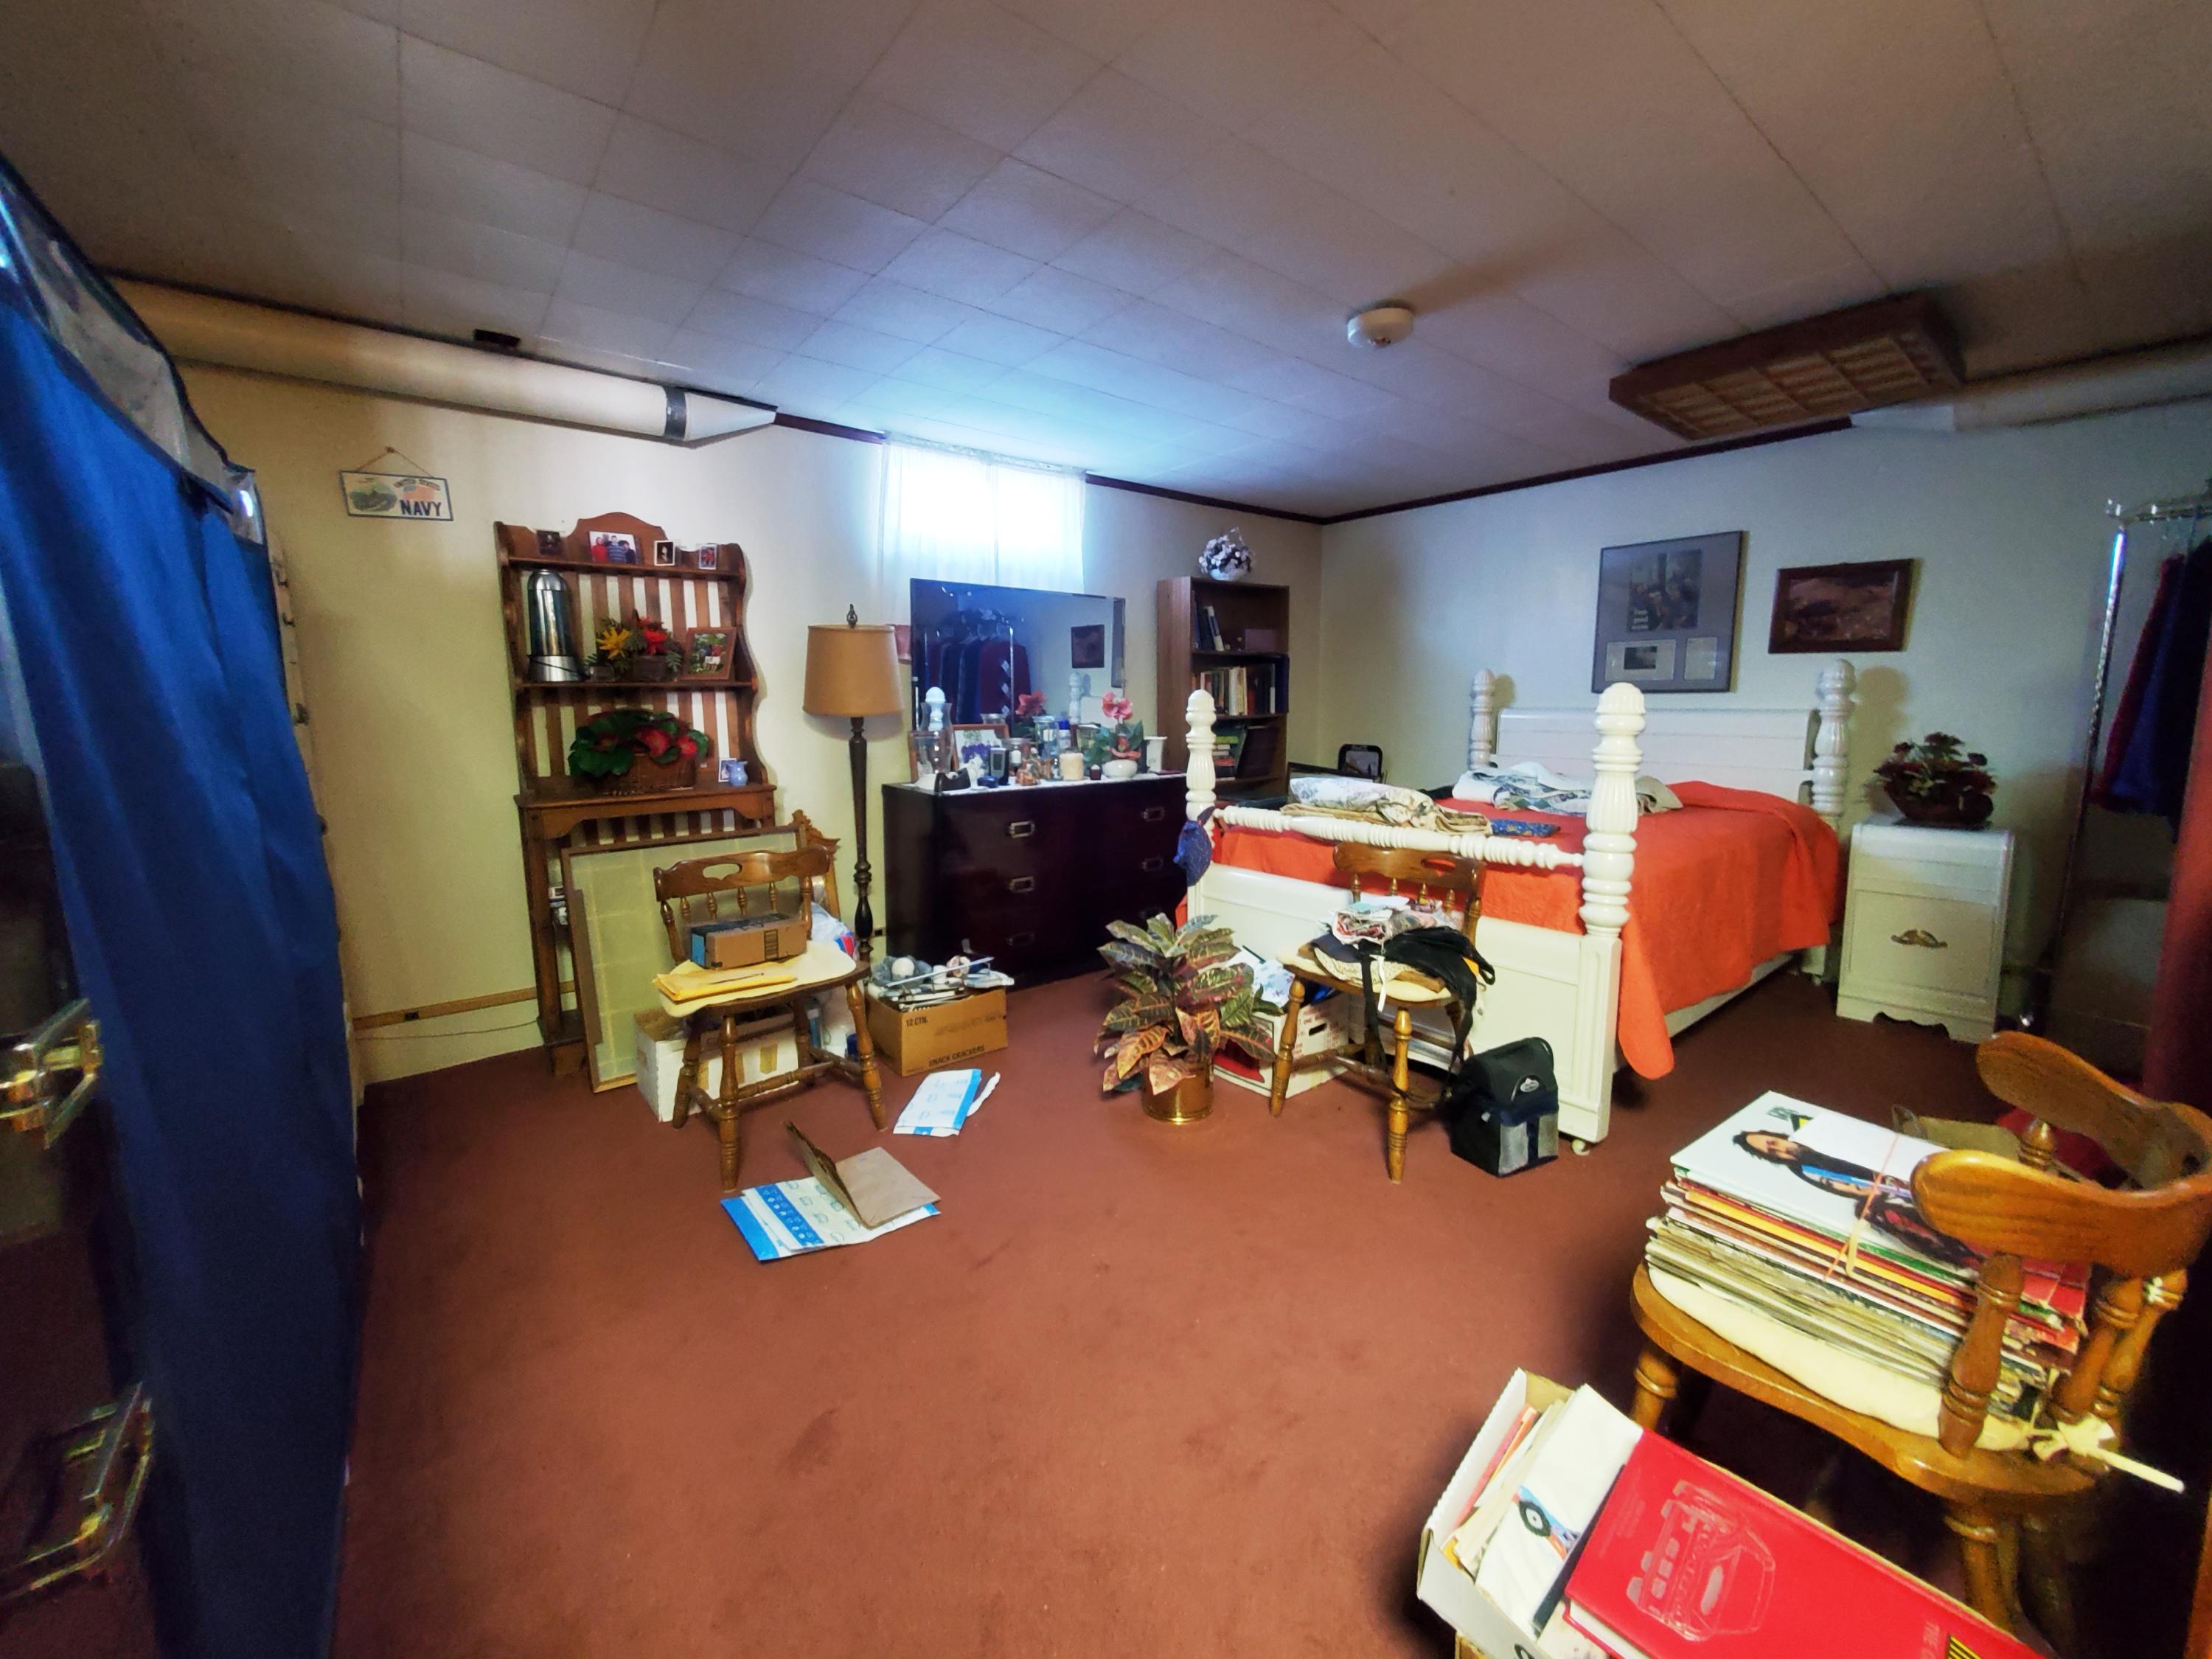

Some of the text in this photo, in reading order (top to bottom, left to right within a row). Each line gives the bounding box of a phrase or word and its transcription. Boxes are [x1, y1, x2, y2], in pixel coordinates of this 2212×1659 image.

[400, 499, 442, 516] NAVY
[928, 1044, 985, 1067] SNACK CRACKERS
